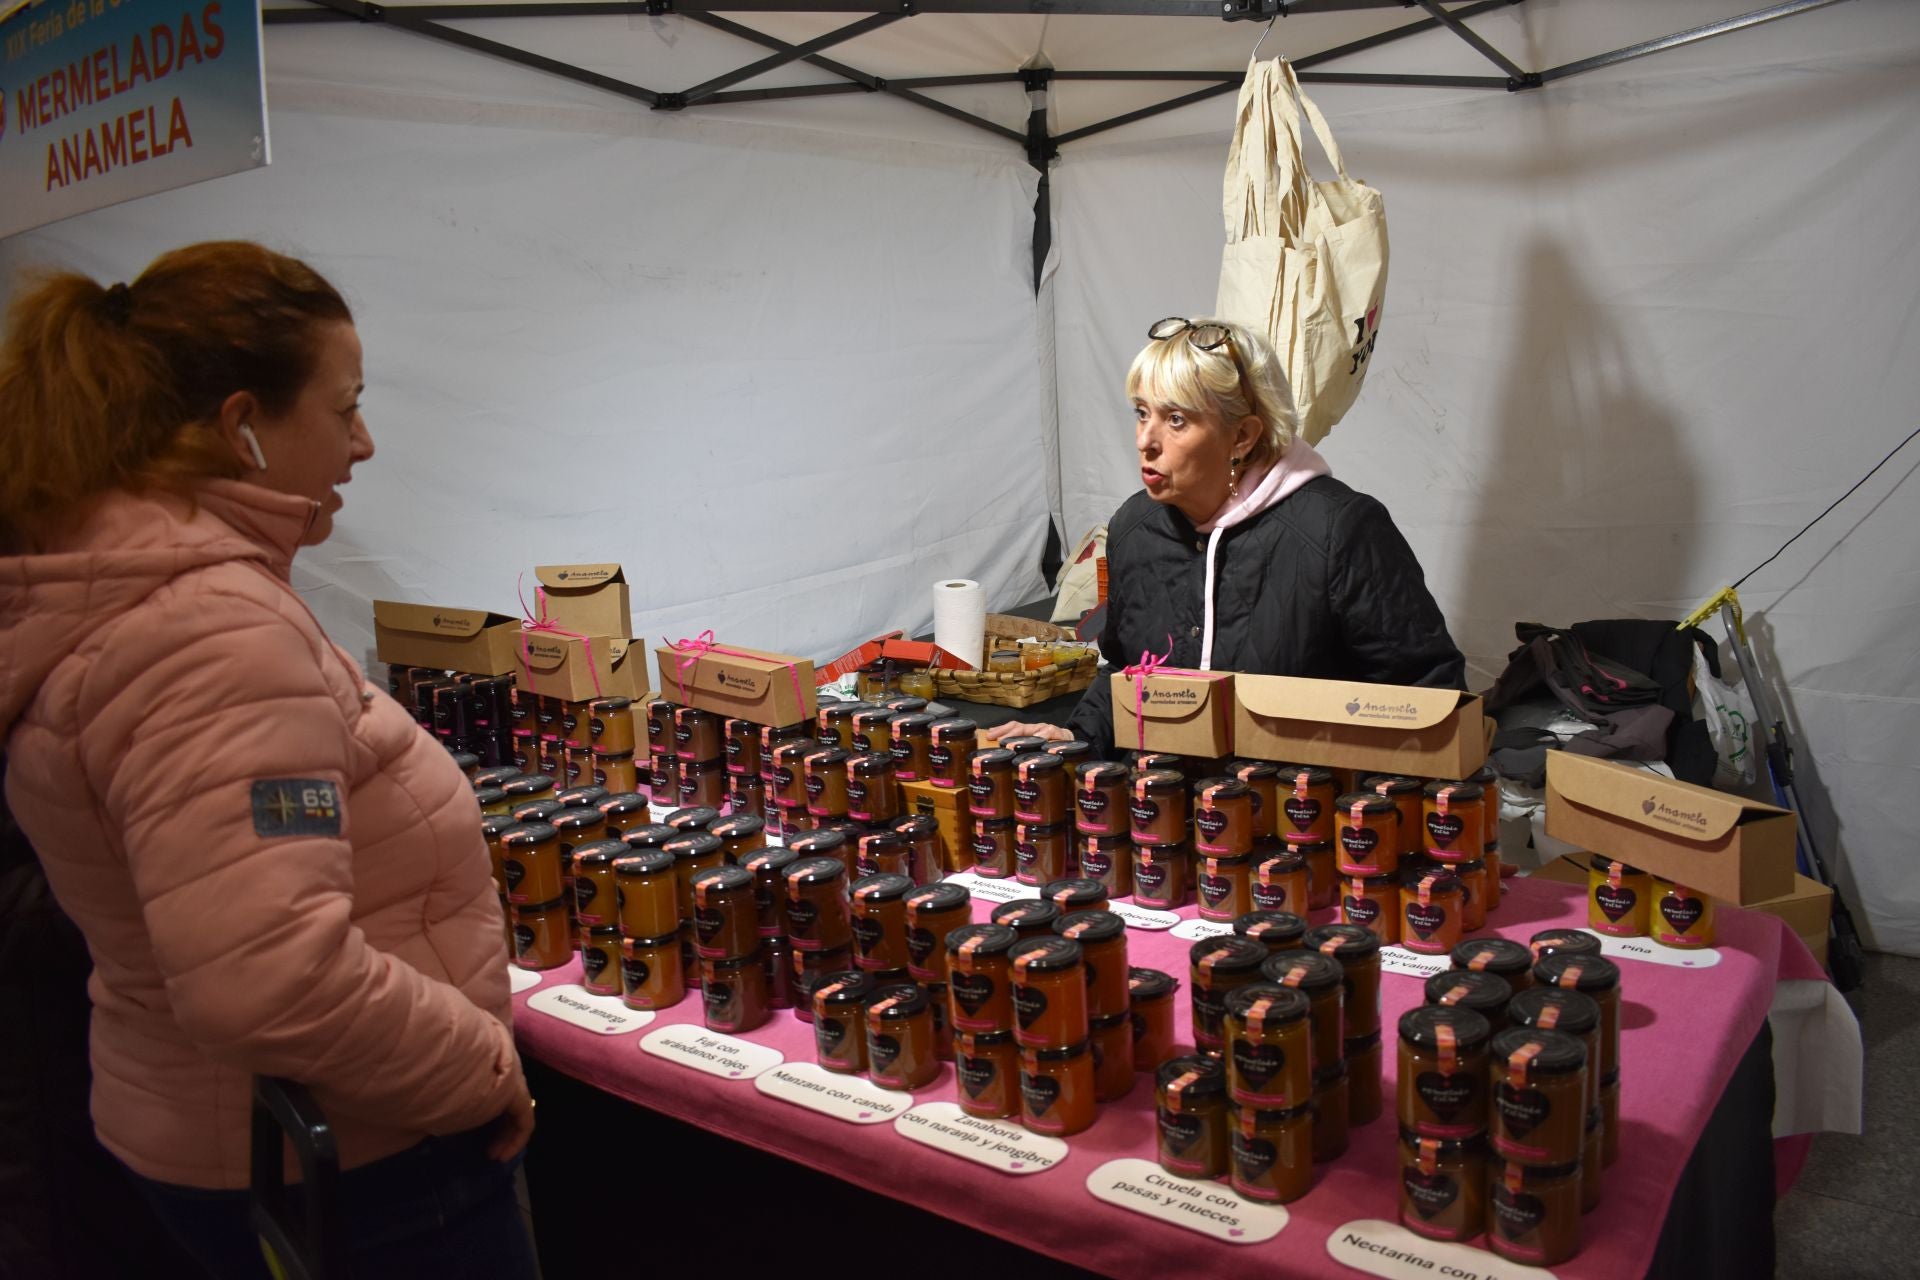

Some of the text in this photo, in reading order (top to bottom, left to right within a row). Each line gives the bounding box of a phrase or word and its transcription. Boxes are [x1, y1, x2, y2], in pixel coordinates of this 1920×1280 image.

[29, 8, 65, 47] Feria
[66, 0, 86, 30] de
[17, 3, 225, 135] MERMELADAS
[46, 96, 193, 192] ANAMELA
[1152, 688, 1197, 699] Anamela
[1362, 702, 1417, 715] Anamela
[302, 788, 334, 807] 63
[1657, 802, 1708, 827] Anamela
[553, 994, 627, 1024] Naranja amarga
[715, 1043, 740, 1055] con
[717, 1055, 749, 1072] rojos
[772, 1070, 895, 1115] Manzana con canela
[902, 1111, 1053, 1167] con naranja y jengibre
[954, 1114, 1023, 1142] Zanahoria
[1112, 1180, 1241, 1226] pasas y nueces
[1145, 1173, 1239, 1209] Ciruela con
[1342, 1233, 1478, 1280] Nectarina con
